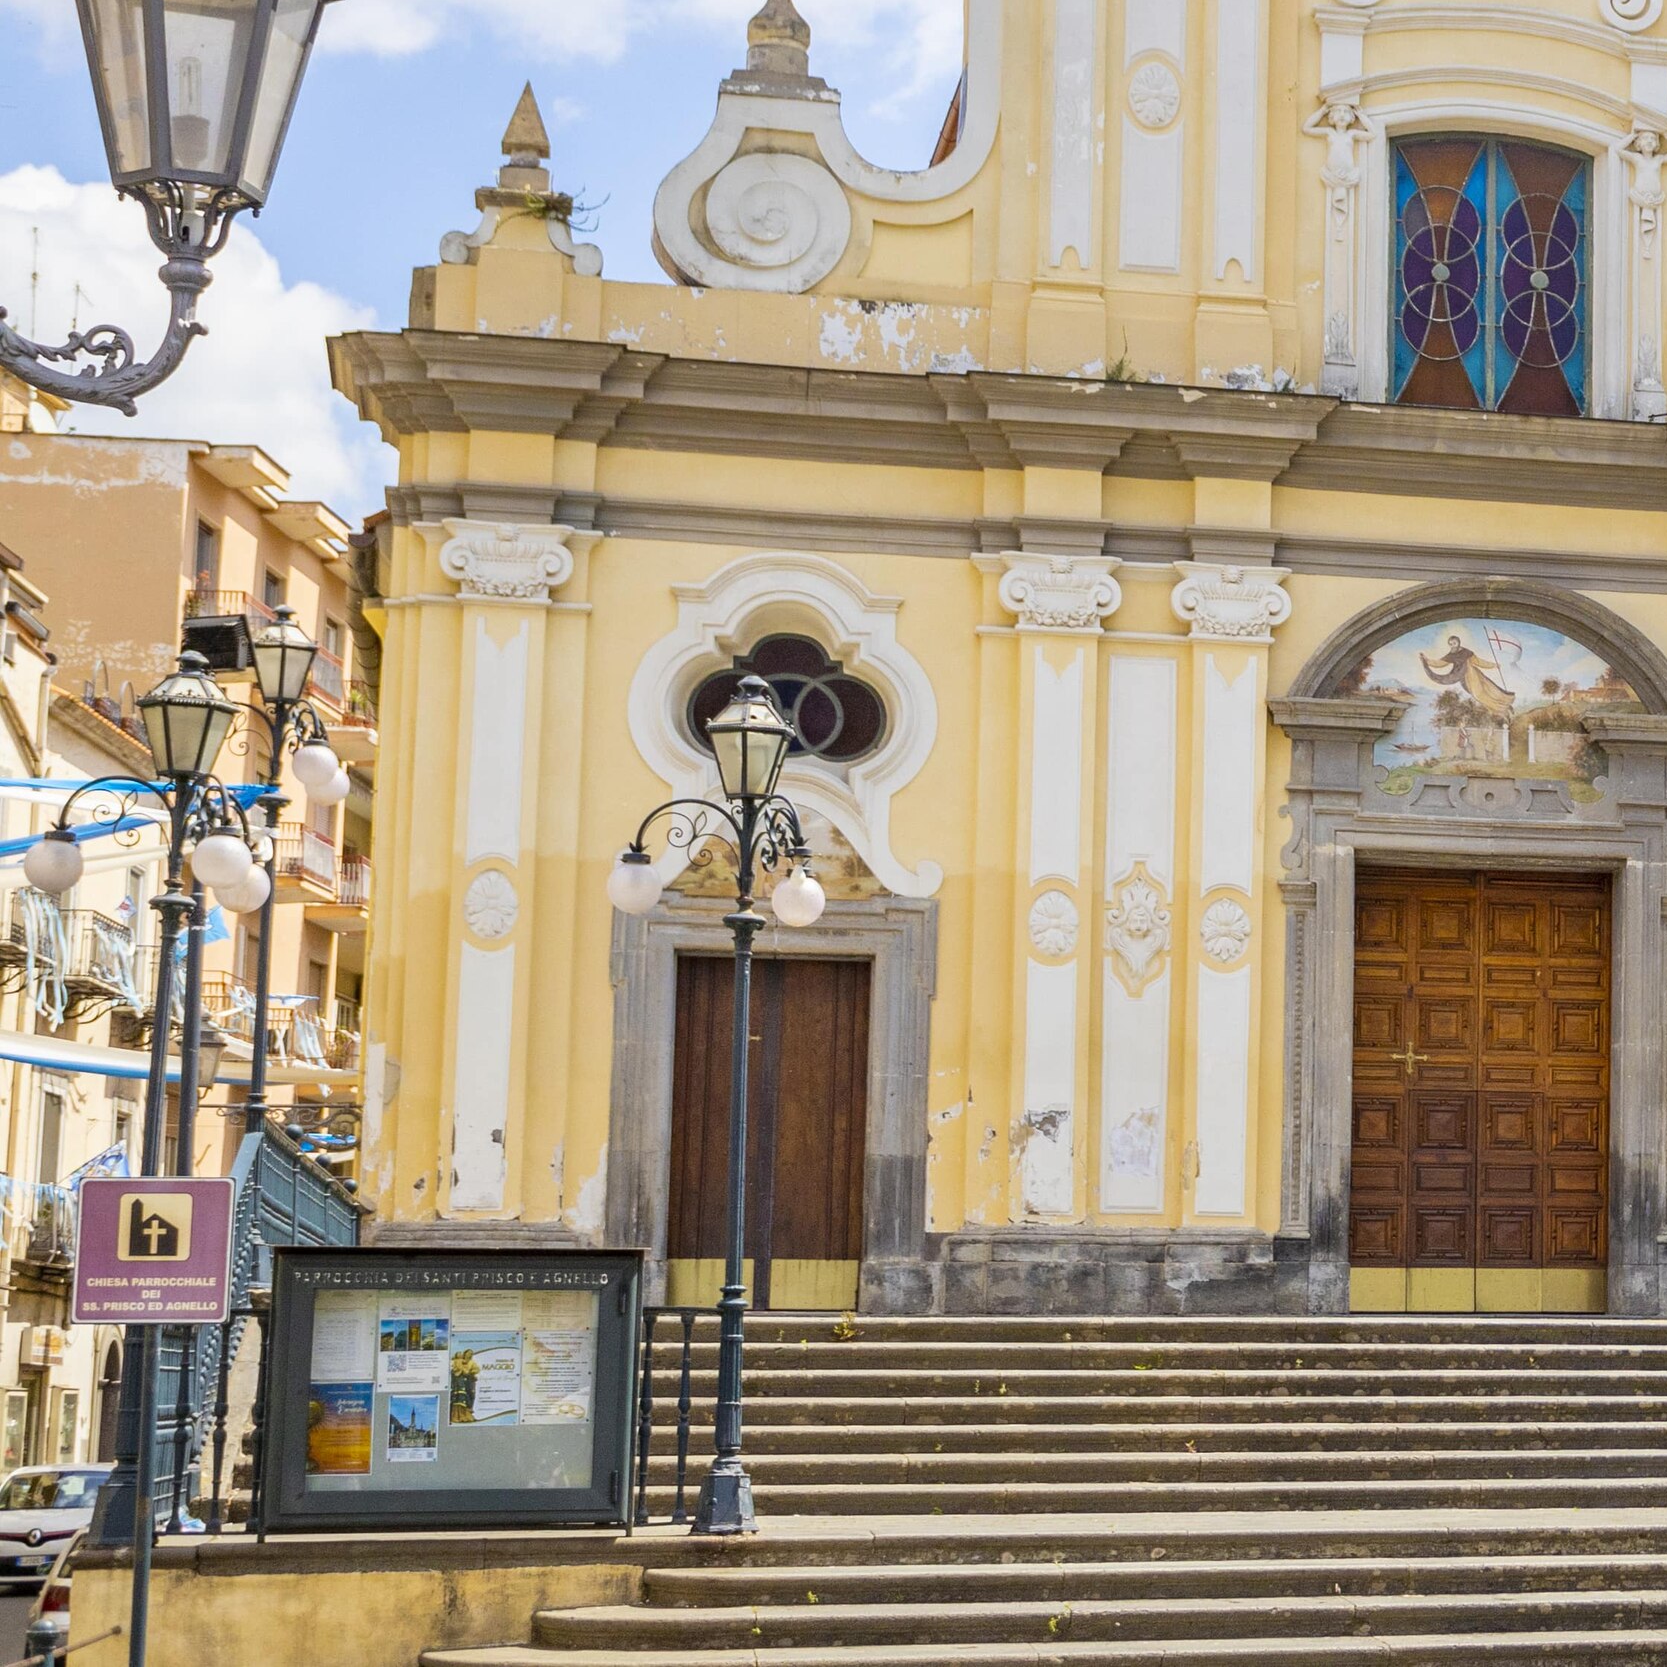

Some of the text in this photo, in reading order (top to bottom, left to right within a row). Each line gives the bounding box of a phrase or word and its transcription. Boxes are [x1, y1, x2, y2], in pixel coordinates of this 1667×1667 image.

[87, 1277, 217, 1287] CHIESA PARROCCHIALE
[294, 1271, 609, 1284] PARROCCHIA DEI SANTI PRISCO E AGNELLO
[141, 1290, 161, 1299] DEI
[82, 1302, 218, 1311] SS. PRISCO ED AGNELLO
